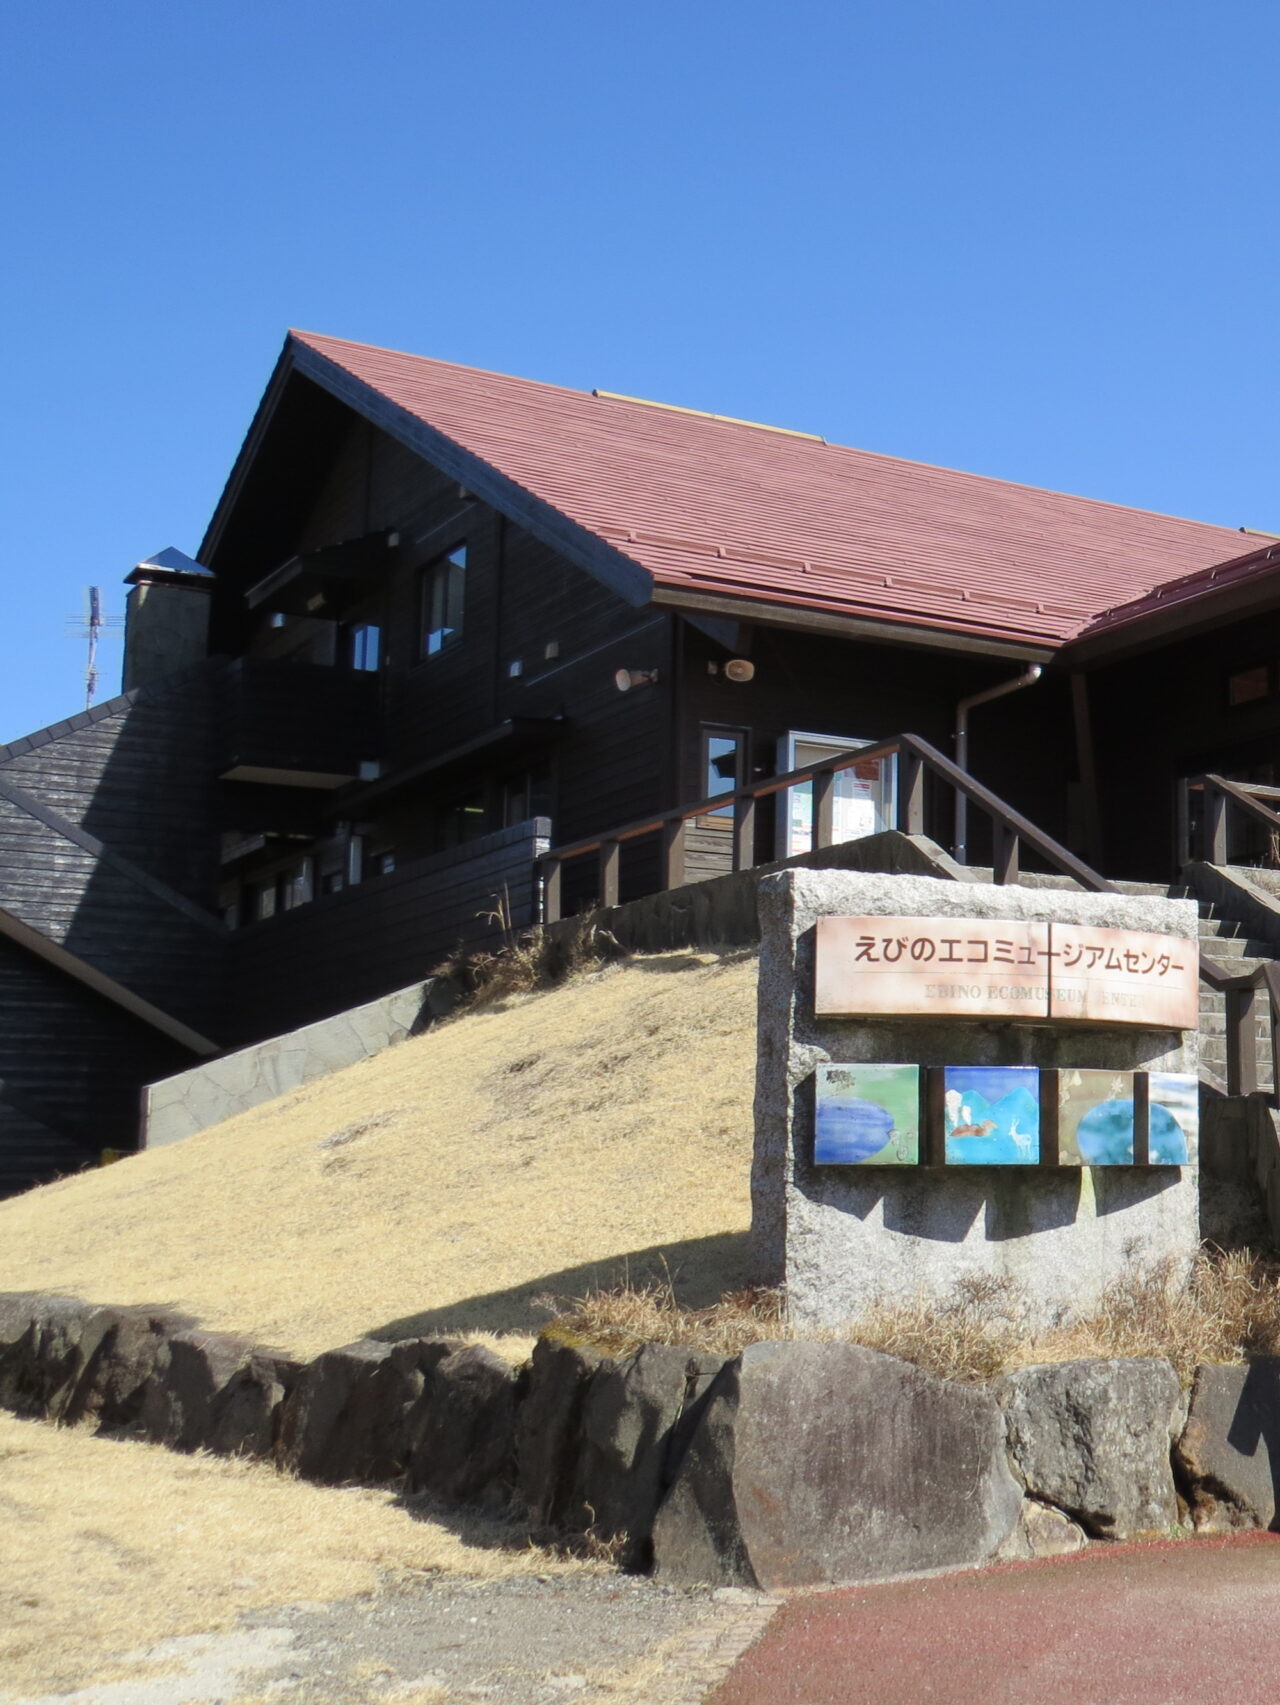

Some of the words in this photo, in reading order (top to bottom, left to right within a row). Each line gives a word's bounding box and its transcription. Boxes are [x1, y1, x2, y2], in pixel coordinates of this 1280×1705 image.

[855, 936, 1184, 977] えびのエコミュージアムセンター
[925, 984, 981, 1000] EBINO
[988, 985, 1087, 1003] ECOMUSEUM
[1092, 990, 1144, 1009] ENTE
